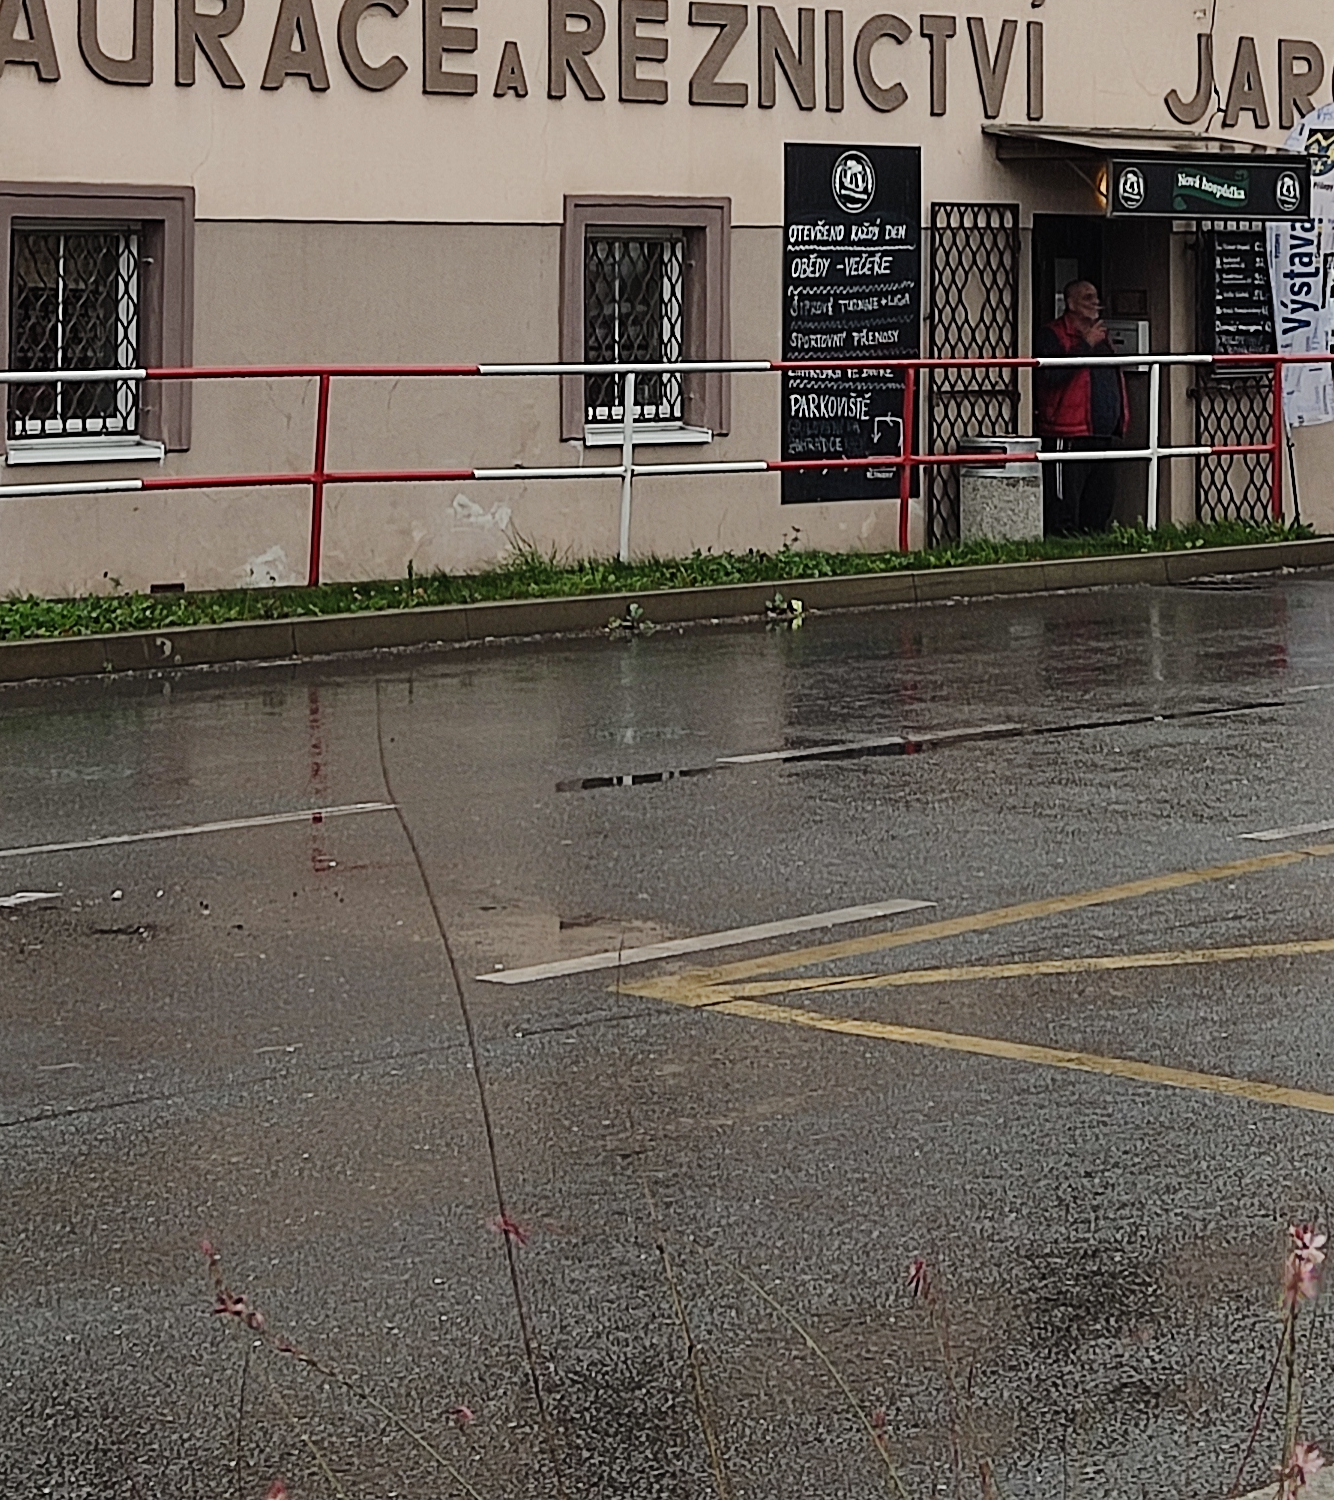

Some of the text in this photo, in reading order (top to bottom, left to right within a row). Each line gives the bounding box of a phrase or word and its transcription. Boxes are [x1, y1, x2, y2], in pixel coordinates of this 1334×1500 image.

[493, 40, 529, 100] A
[1177, 173, 1201, 189] Nová
[788, 217, 907, 243] OTEVŘENO KAŽDÝ DEN
[791, 253, 831, 279] OBĚDY
[1279, 217, 1322, 336] Výstava
[851, 328, 900, 347] PŘENOSY
[789, 392, 872, 421] PARKOVIŠTĚ
